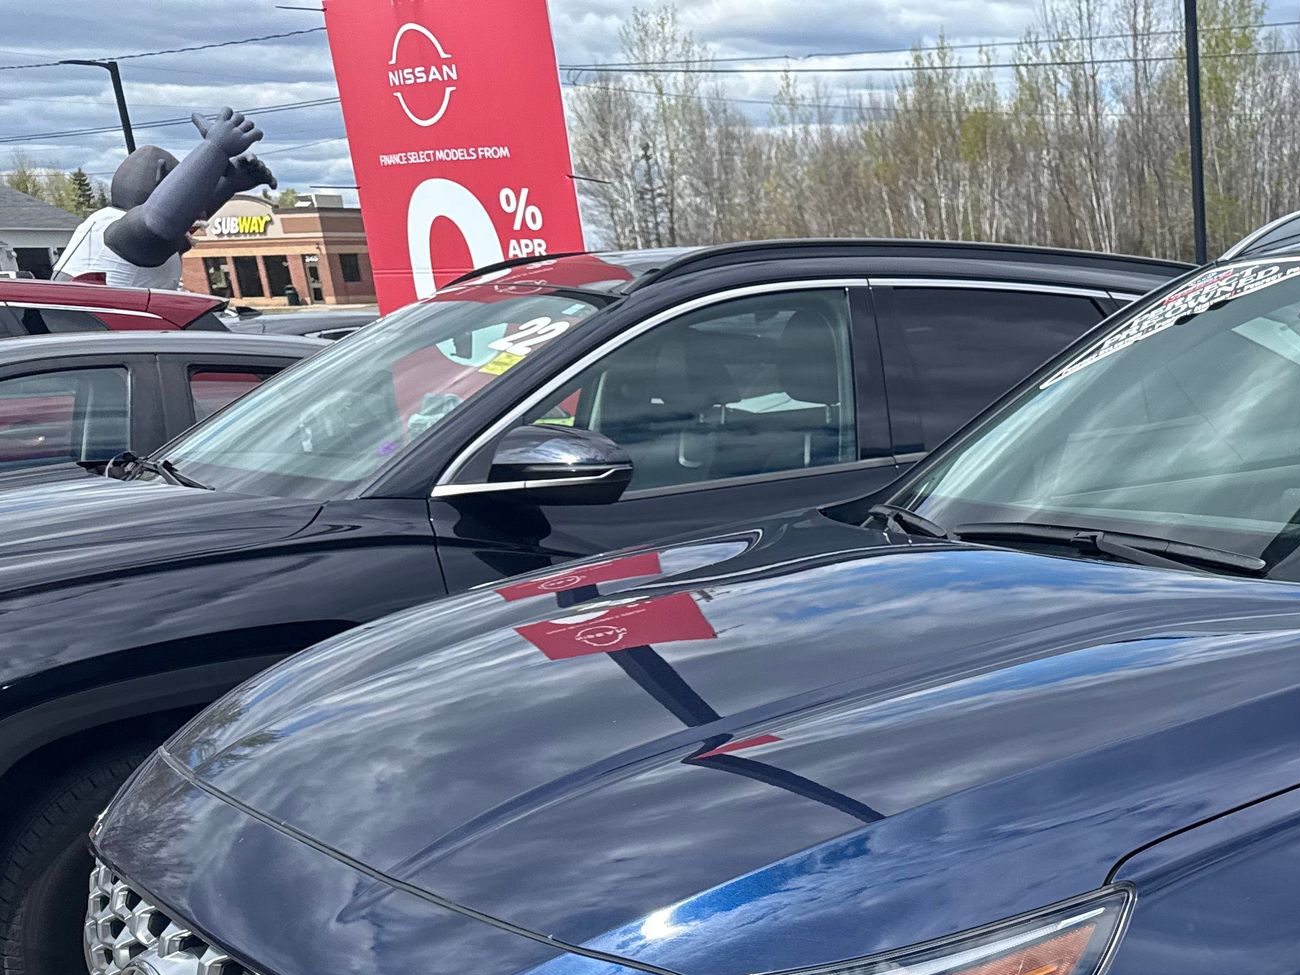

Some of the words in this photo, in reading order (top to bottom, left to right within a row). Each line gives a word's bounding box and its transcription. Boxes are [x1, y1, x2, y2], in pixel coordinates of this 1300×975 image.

[388, 64, 458, 87] NISSAN
[379, 153, 407, 166] FINANCE
[407, 151, 435, 164] SELECT
[435, 148, 477, 161] MODELS
[478, 146, 510, 159] FROM
[211, 214, 272, 236] SUBWAY
[508, 239, 547, 259] APR
[1131, 265, 1261, 327] PERFECT
[488, 316, 570, 355] 22
